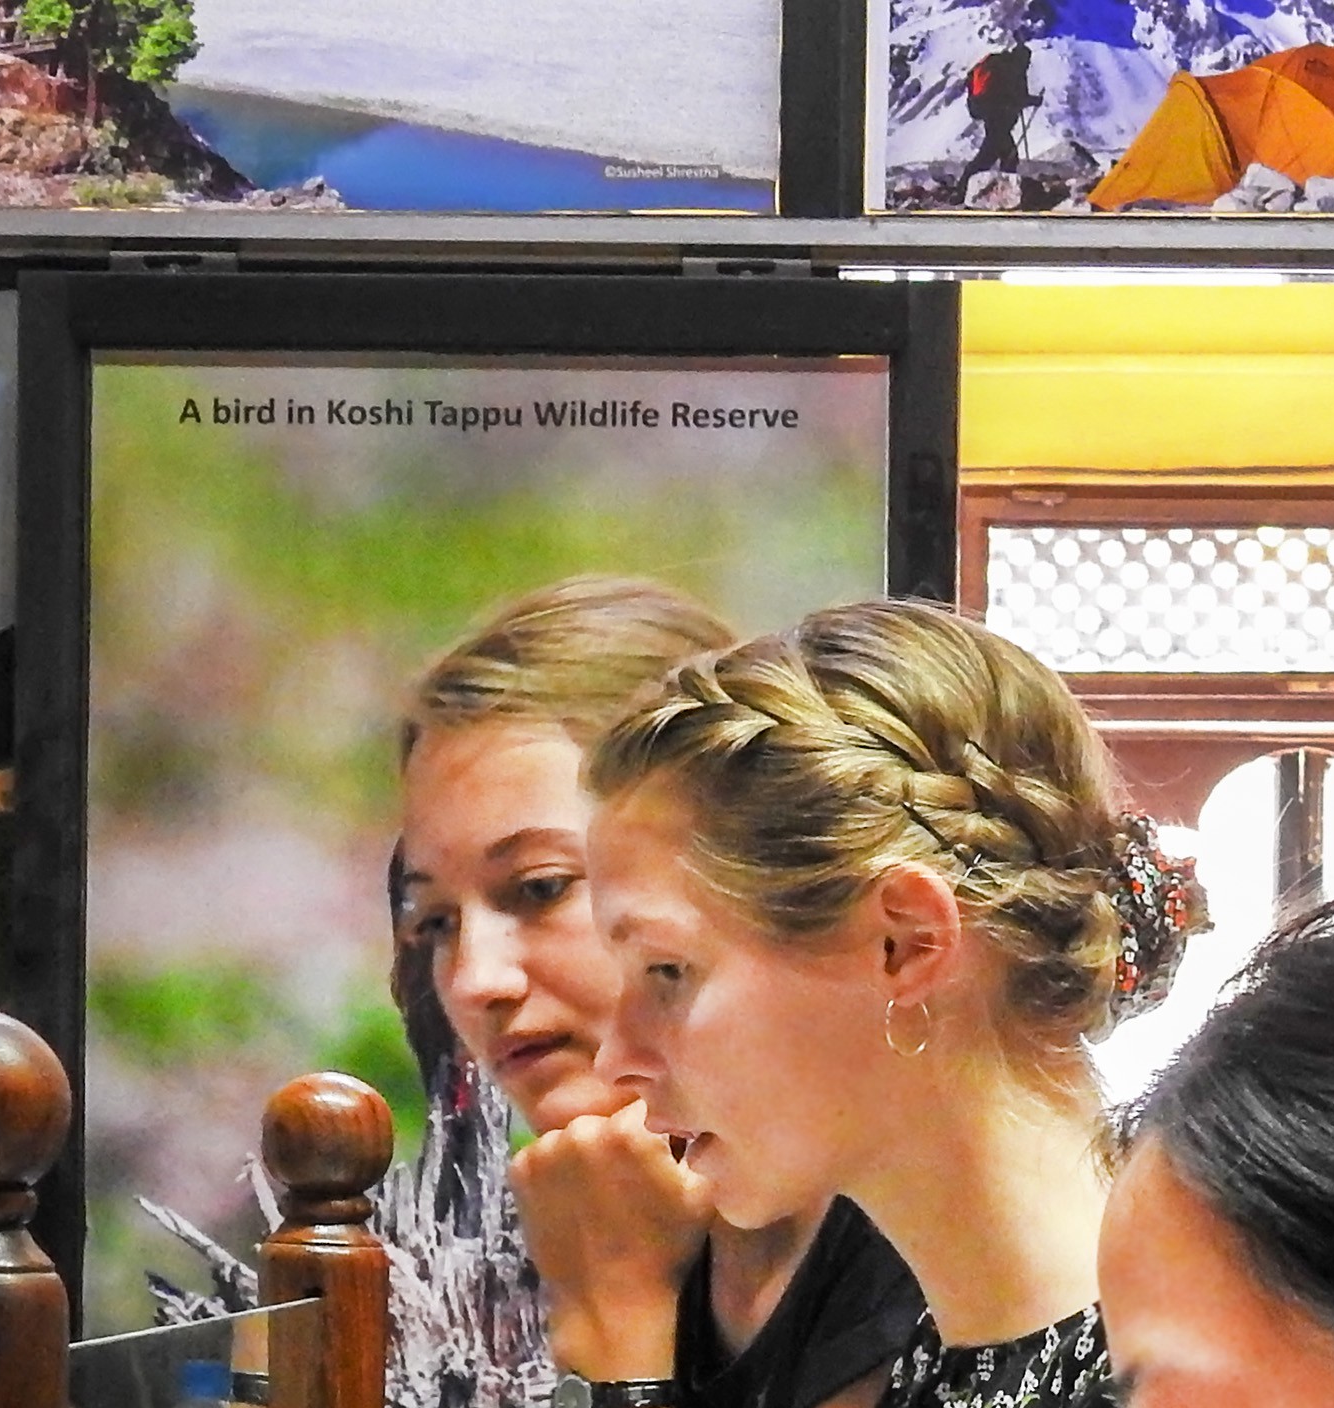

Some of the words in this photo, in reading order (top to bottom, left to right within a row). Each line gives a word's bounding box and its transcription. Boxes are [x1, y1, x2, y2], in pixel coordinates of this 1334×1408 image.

[178, 398, 201, 424] A
[213, 397, 275, 424] bird
[287, 398, 315, 424] in
[327, 398, 413, 425] Koshi
[424, 400, 522, 432] Tappu
[534, 400, 660, 428] Wildlife
[671, 401, 800, 428] Reserve
